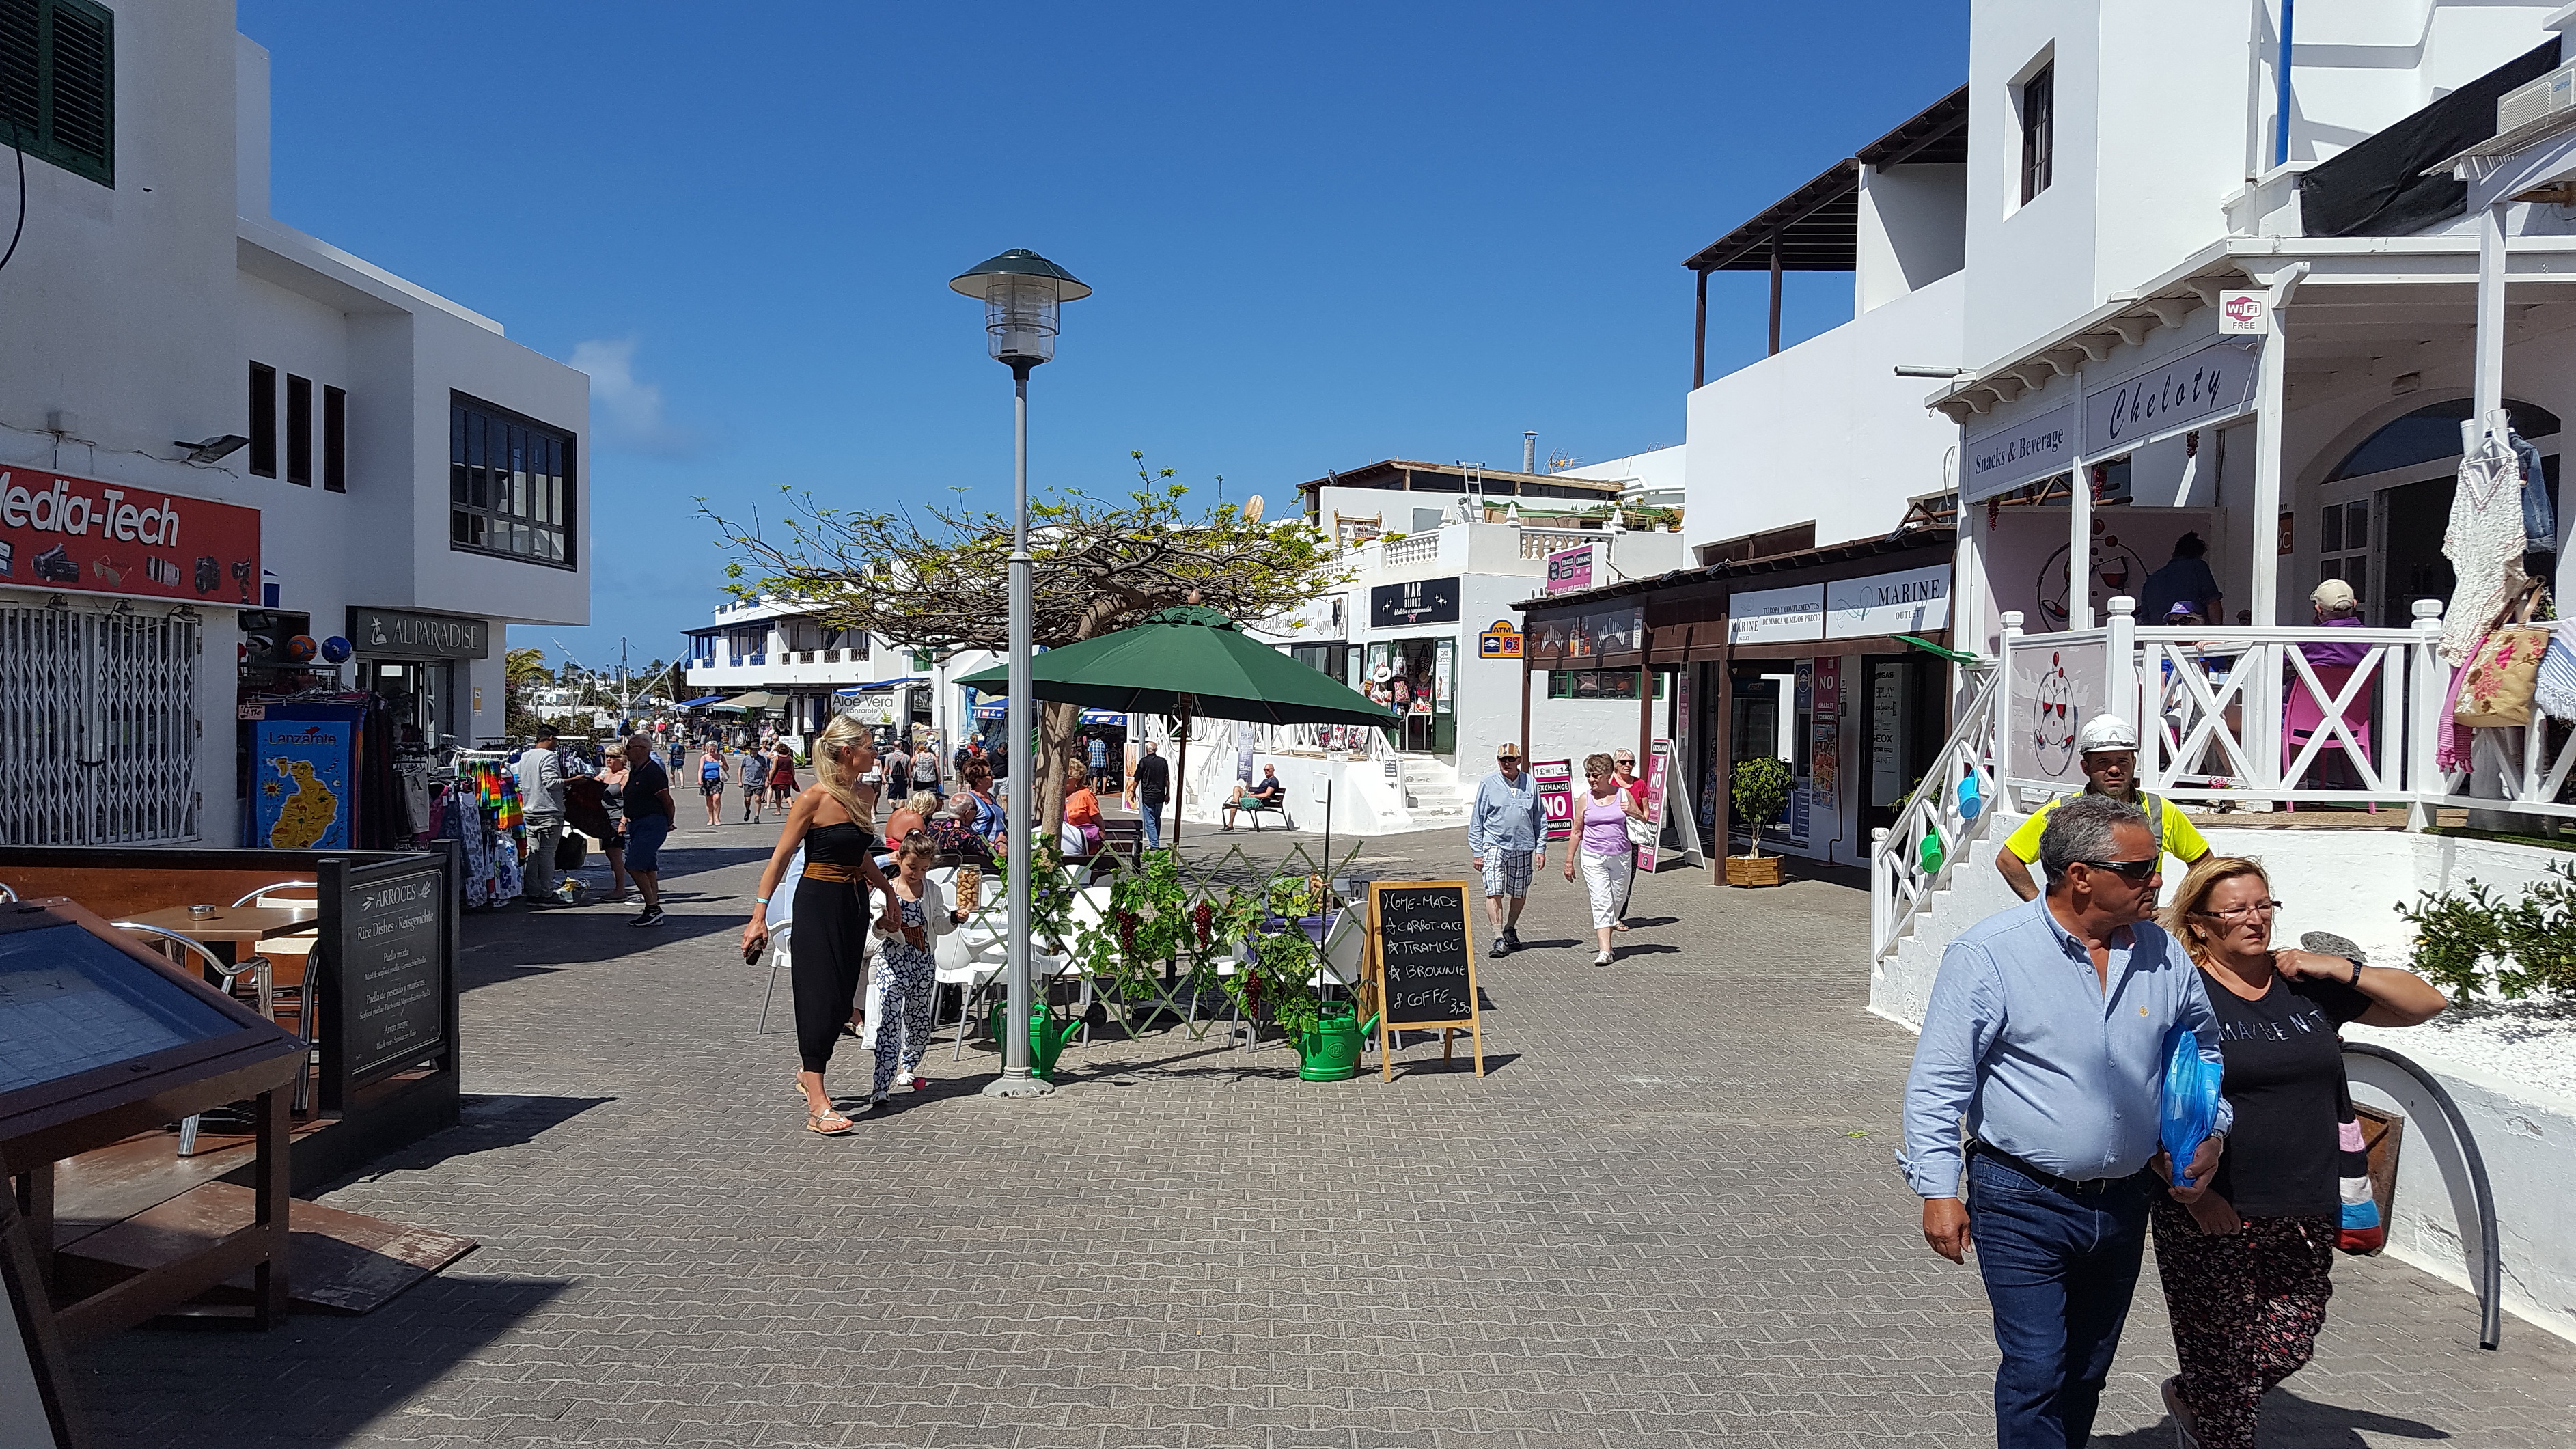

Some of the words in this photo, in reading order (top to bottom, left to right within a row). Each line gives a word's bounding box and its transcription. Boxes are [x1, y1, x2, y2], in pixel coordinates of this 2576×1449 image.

[2109, 365, 2221, 441] Cheloty
[1976, 446, 2006, 475] Snacks
[2008, 445, 2017, 463] &
[2019, 427, 2064, 460] Beverage
[1404, 582, 1422, 598] MAR
[1878, 579, 1940, 606] MARINE
[1404, 598, 1421, 608] BIJOUX
[1769, 606, 1780, 614] ROPA
[1784, 602, 1820, 613] COMPLEMENTOS
[1314, 608, 1331, 635] Liam
[1762, 618, 1768, 626] DE
[1769, 616, 1784, 625] MARCA
[1784, 616, 1789, 624] AL
[1790, 615, 1804, 624] MEJOR
[1805, 613, 1821, 622] PRECIO
[1895, 609, 1921, 620] OUTLET
[1731, 620, 1759, 633] MARINE
[392, 618, 413, 644] AL
[415, 620, 478, 652] PARADISE
[1819, 676, 1833, 690] NO
[1876, 687, 1894, 698] EPLAY
[833, 695, 861, 707] Aloe
[865, 695, 893, 707] Vera
[268, 732, 337, 745] Lanzarote
[1538, 783, 1568, 792] EXCHANGE
[1650, 772, 1661, 789] NO
[1541, 795, 1566, 817] NO
[376, 883, 417, 909] ARROCES
[1383, 891, 1459, 913] HOME-MADE
[357, 926, 372, 941] Rice
[372, 917, 395, 937] Dishes
[398, 908, 434, 931] Reisgerichte
[383, 948, 397, 963] Paella
[396, 947, 410, 958] mixta
[1405, 964, 1466, 978] BROWNIE
[366, 991, 380, 1004] Paella
[380, 989, 386, 999] de
[386, 983, 403, 1001] pescado
[1407, 988, 1450, 1007] COFFE
[1448, 998, 1471, 1015] 3,50
